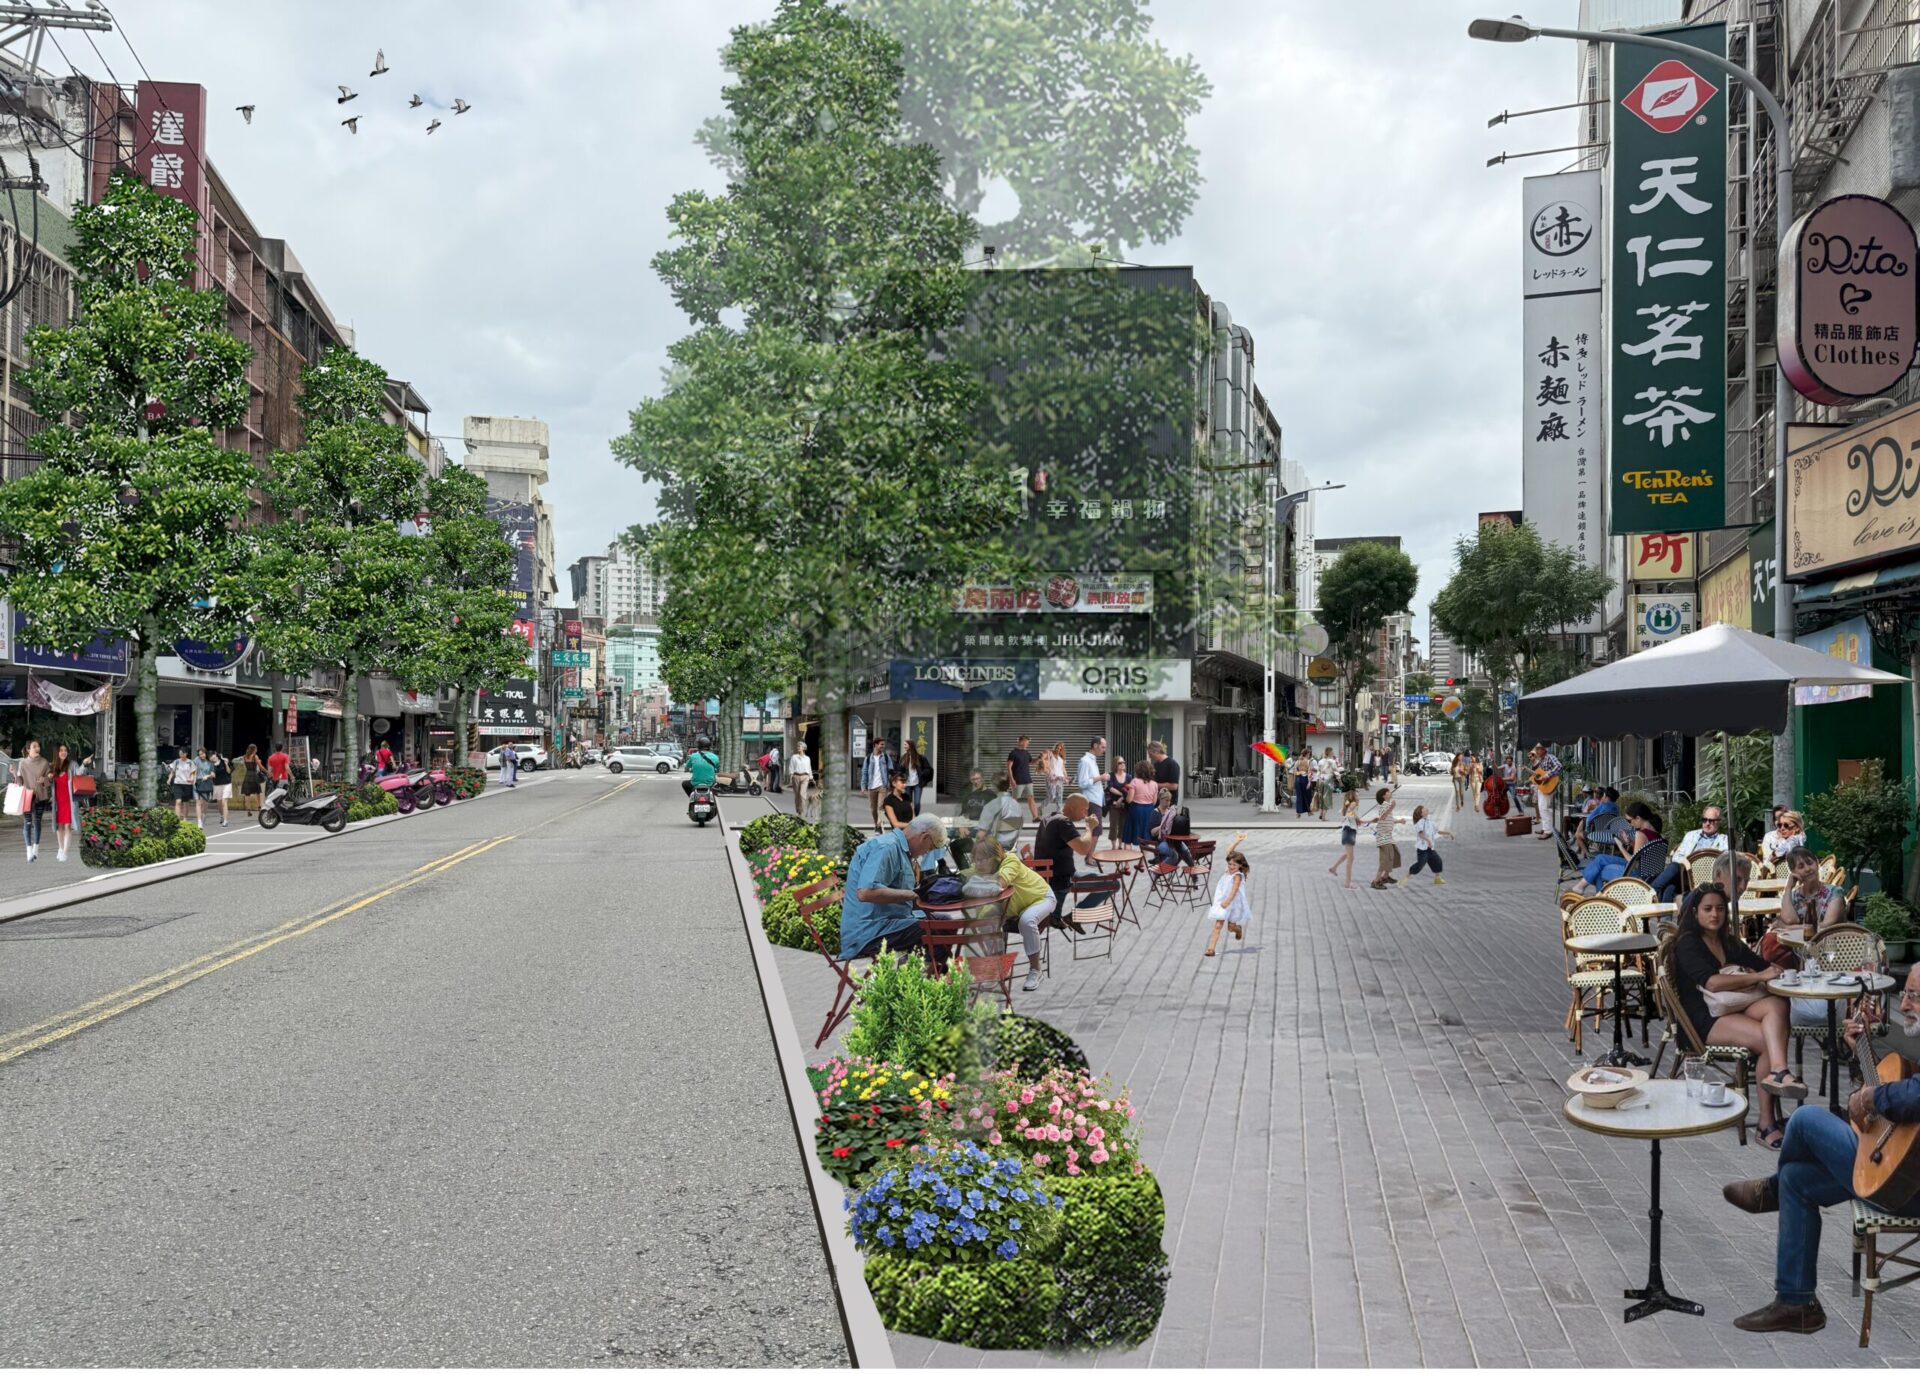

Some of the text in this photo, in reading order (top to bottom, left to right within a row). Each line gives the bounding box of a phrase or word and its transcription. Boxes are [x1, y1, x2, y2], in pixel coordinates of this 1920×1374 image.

[150, 109, 185, 203] 達爵
[1535, 206, 1585, 248] 赤
[1807, 232, 1908, 276] Rita
[1533, 267, 1588, 281] レッドラーメン
[1621, 156, 1716, 447] 天仁茗茶
[1814, 323, 1899, 341] 精品服飾店
[1814, 343, 1900, 365] Clothes
[1536, 335, 1571, 442] 赤麵廠
[1647, 492, 1688, 504] TEA
[1047, 499, 1166, 520] 幸福鍋物
[1853, 516, 1895, 546] love
[1897, 516, 1915, 534] is
[1638, 533, 1689, 574] 所
[1753, 558, 1775, 603] 天仁
[1641, 639, 1670, 648] 特約
[914, 665, 1016, 682] LONGINES
[1082, 666, 1148, 686] ORIS
[494, 689, 527, 699] TICAL
